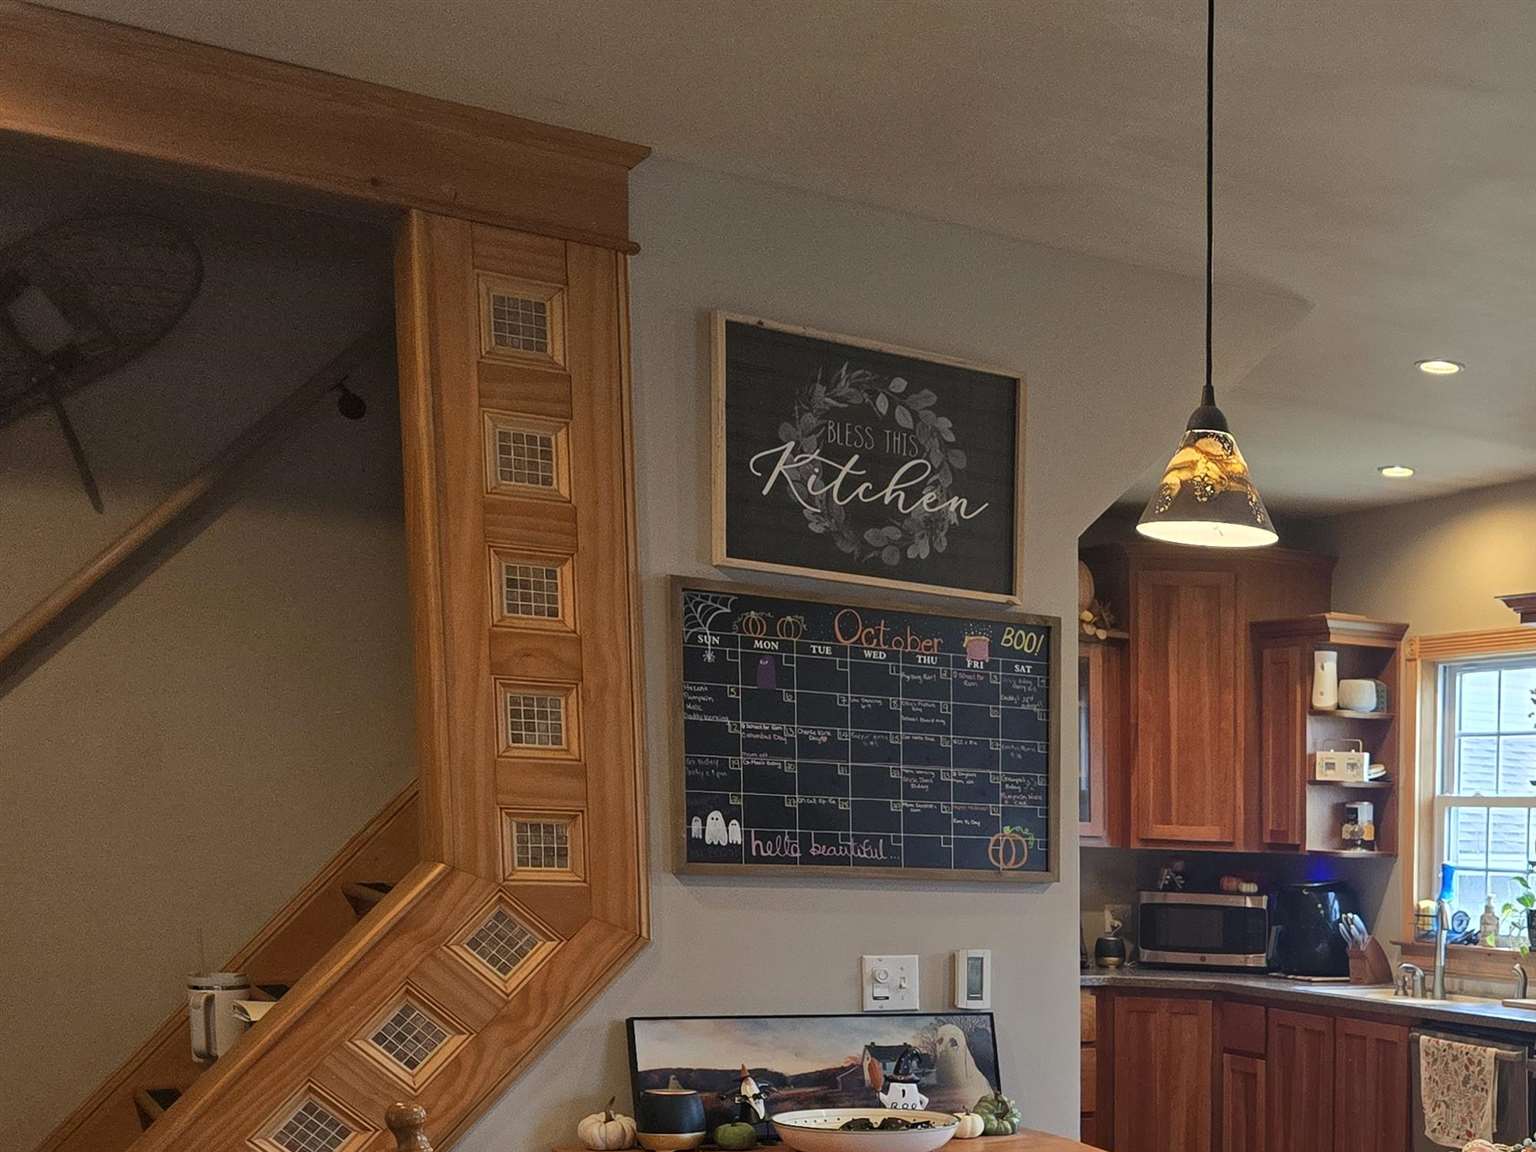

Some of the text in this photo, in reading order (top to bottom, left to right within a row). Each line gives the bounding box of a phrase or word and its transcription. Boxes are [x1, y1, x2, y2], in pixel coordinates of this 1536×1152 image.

[826, 419, 919, 457] BLESS THIS
[749, 440, 989, 519] Kitchen
[834, 608, 944, 655] October
[1000, 626, 1045, 657] BOO!
[697, 634, 1033, 674] SUN MON TUE WED THU FRI SAT
[730, 687, 737, 696] 5
[751, 829, 802, 857] hello
